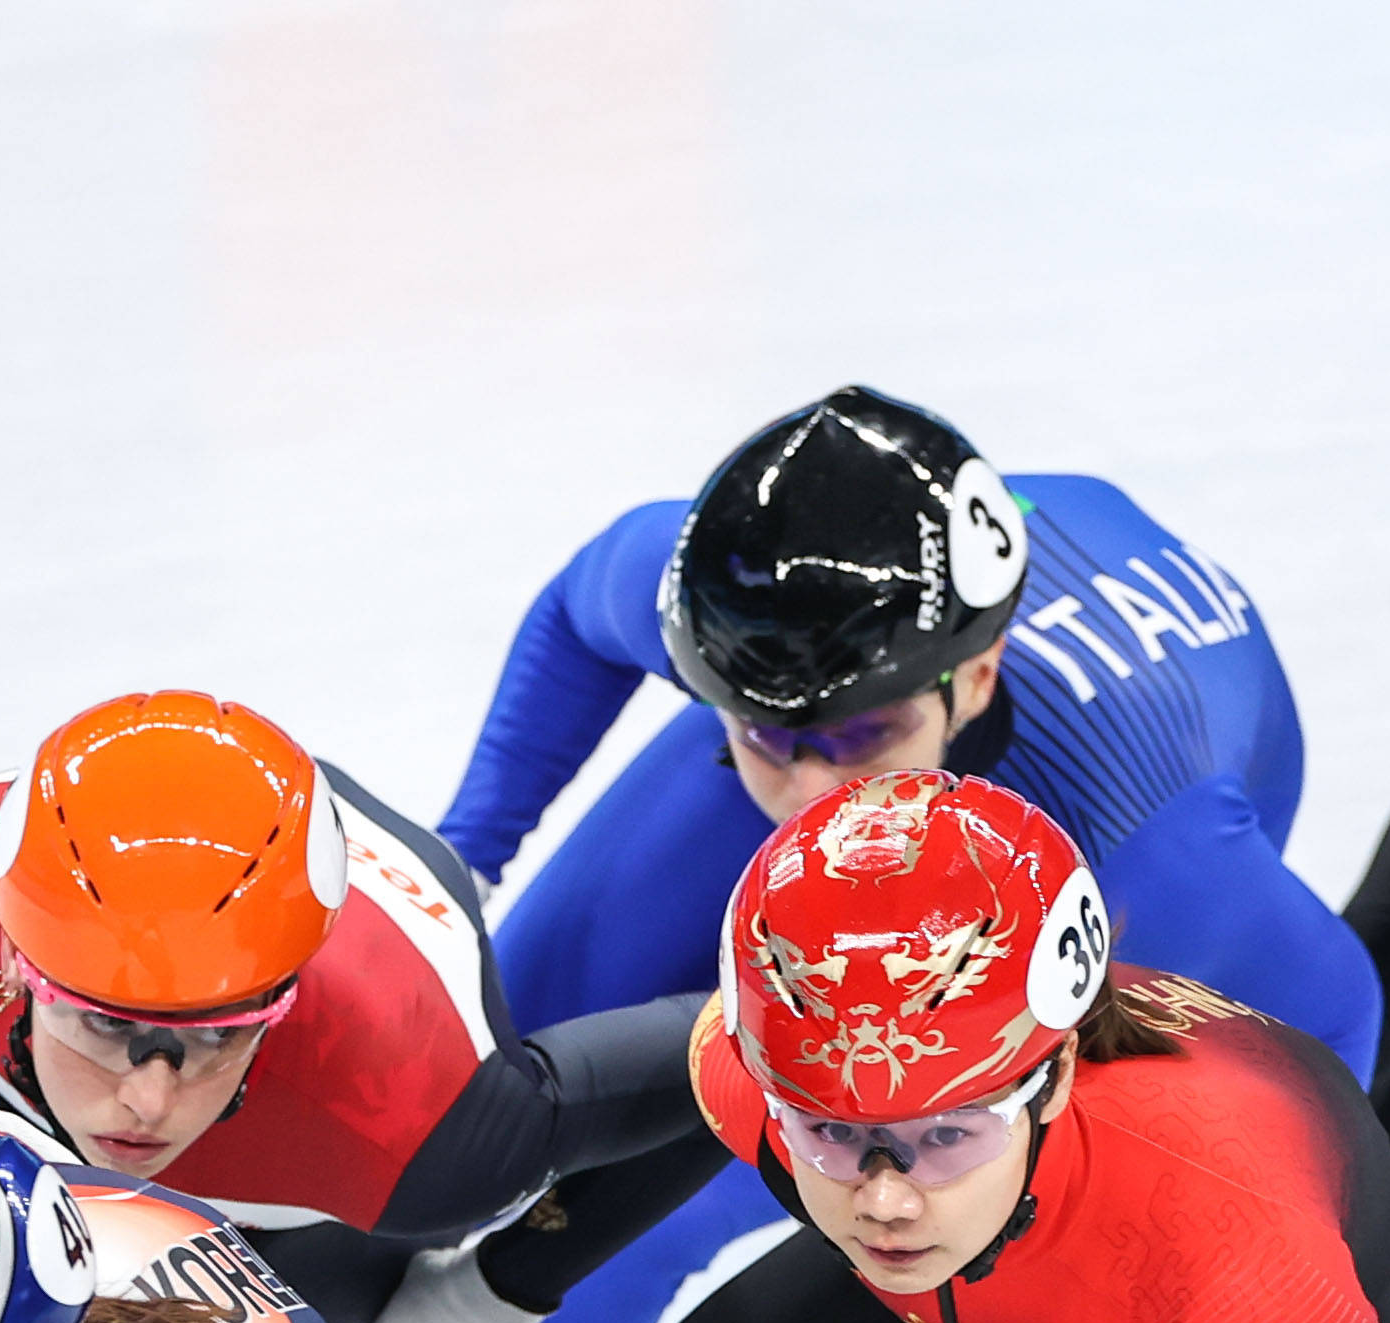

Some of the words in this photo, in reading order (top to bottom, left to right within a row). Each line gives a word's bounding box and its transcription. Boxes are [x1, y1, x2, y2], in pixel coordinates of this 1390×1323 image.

[969, 496, 1011, 560] 3
[1009, 545, 1251, 704] ITALIA
[1058, 895, 1106, 999] 36
